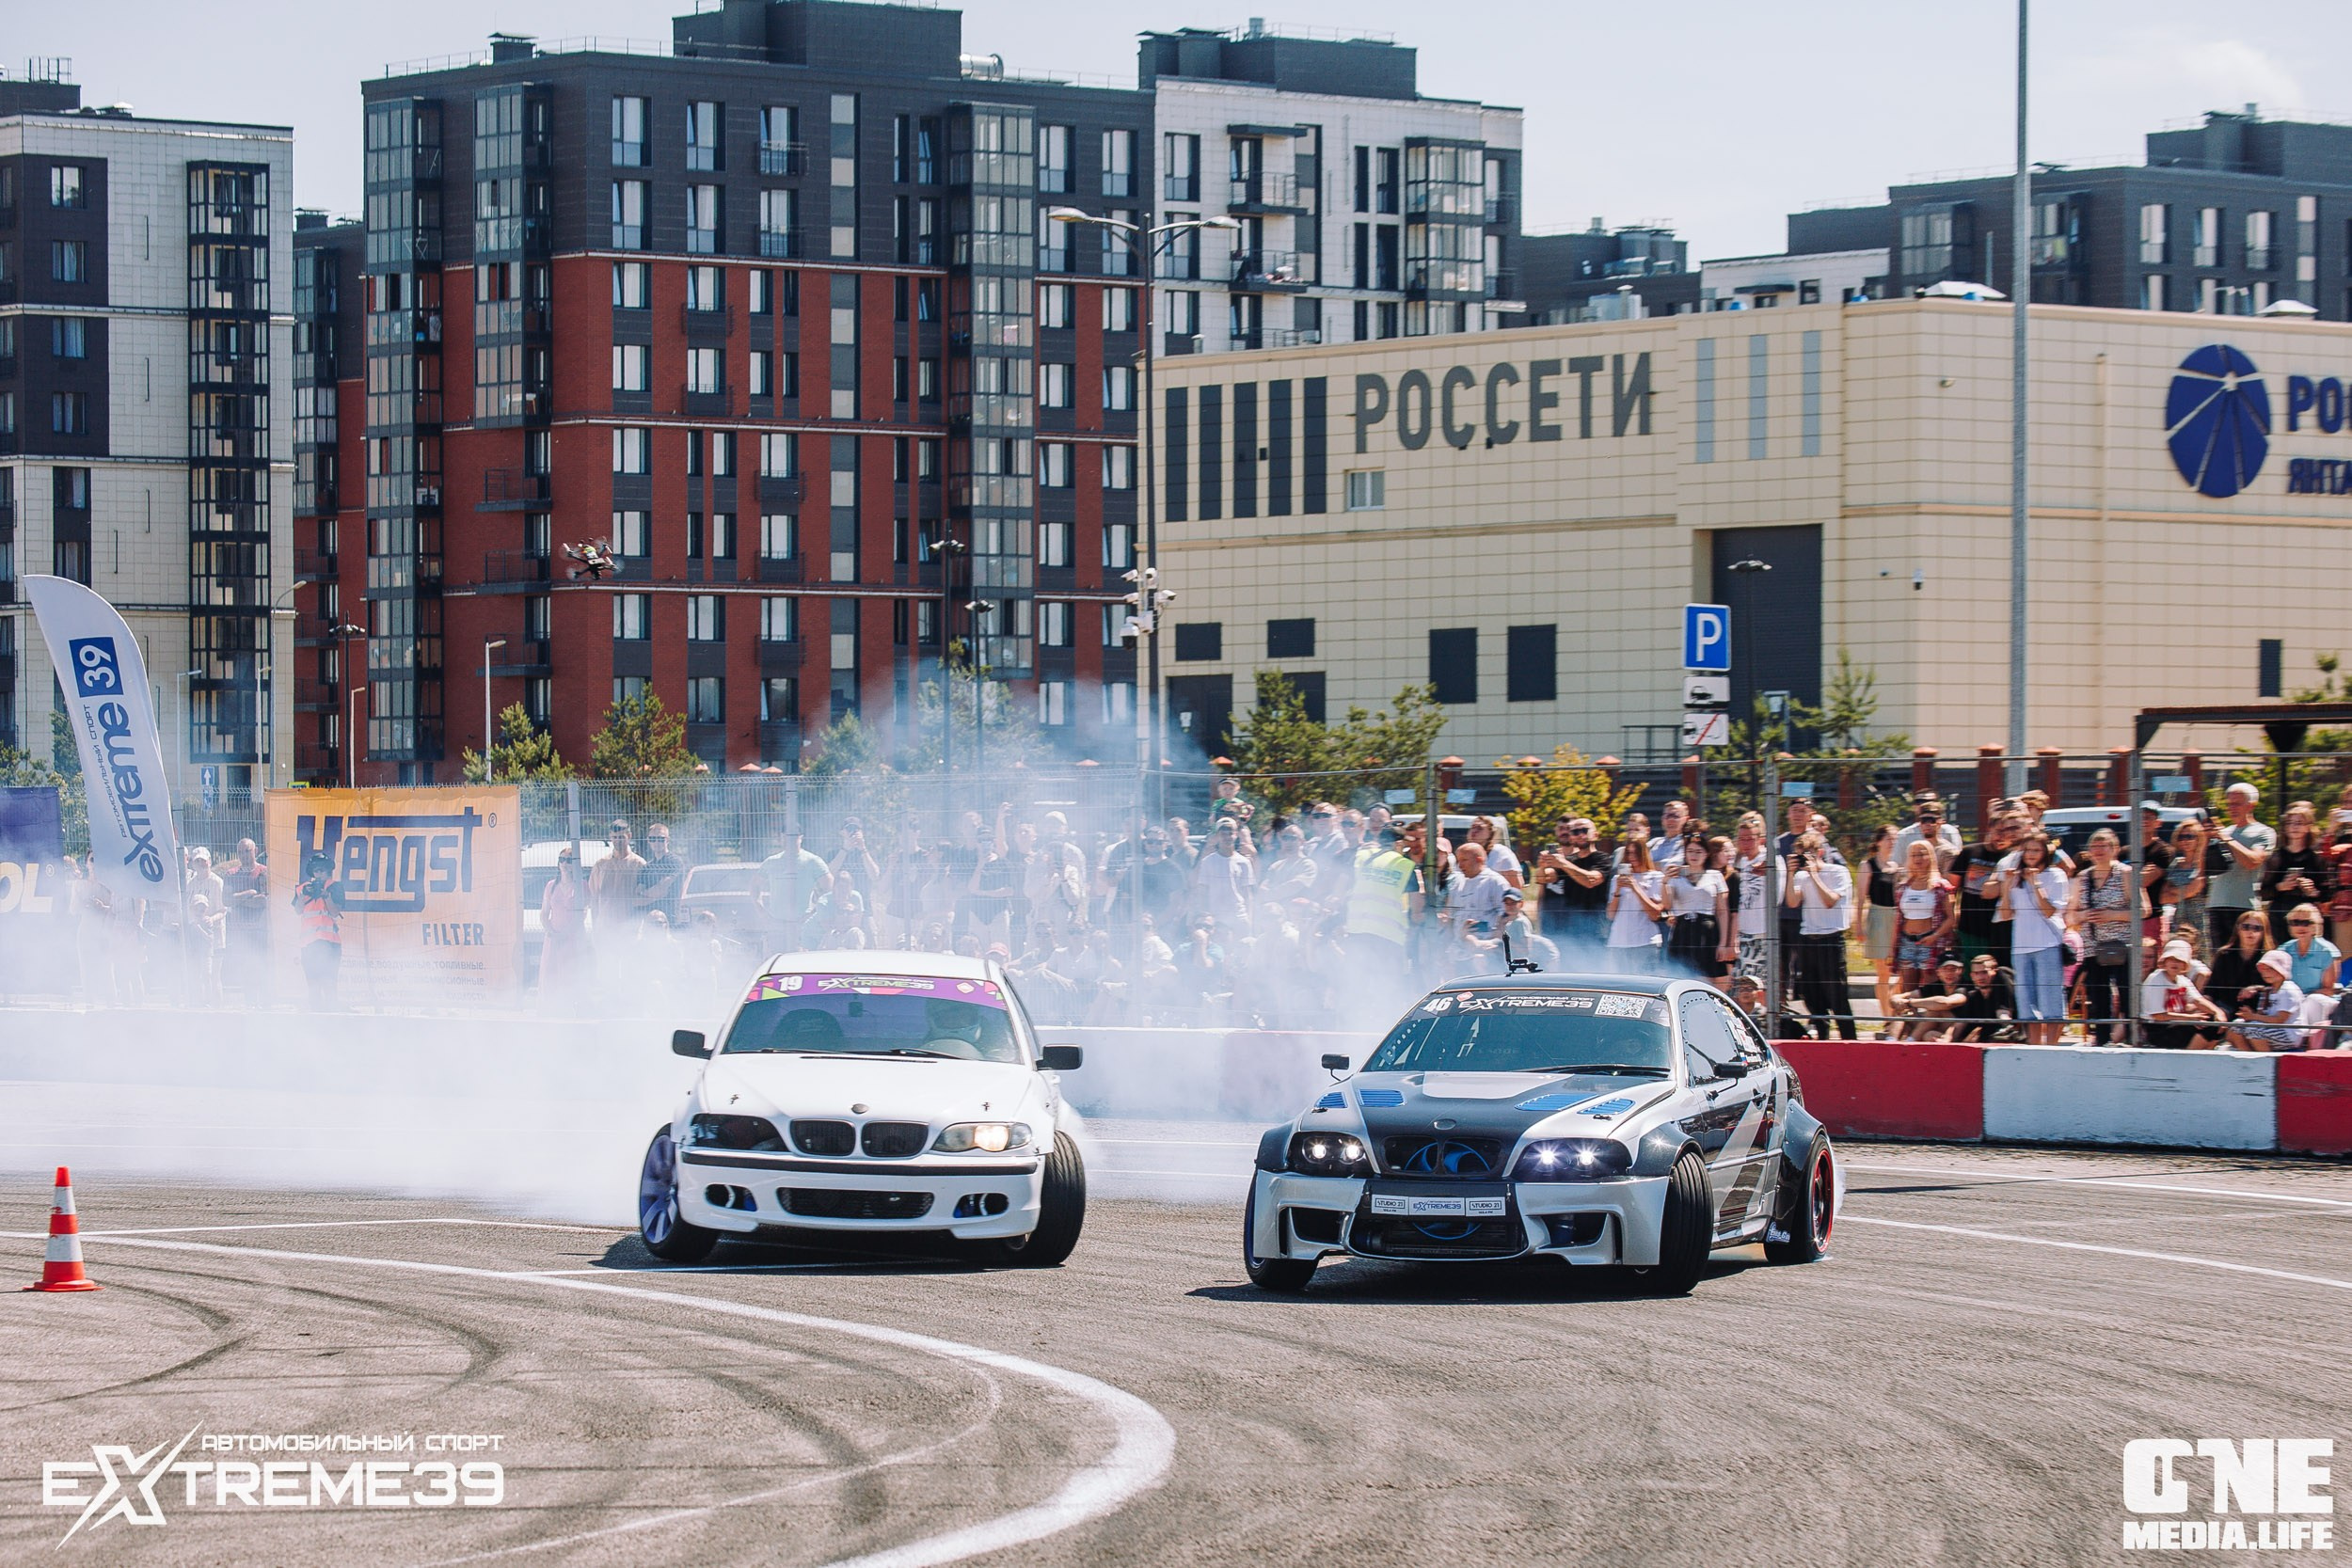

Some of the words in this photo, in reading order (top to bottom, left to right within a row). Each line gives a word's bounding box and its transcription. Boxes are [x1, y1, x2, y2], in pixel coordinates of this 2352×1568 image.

[1355, 352, 1652, 453] РОССЕТИ
[2288, 375, 2352, 434] РО
[1696, 613, 1723, 661] P
[79, 645, 115, 688] 39
[83, 705, 97, 740] СПОРТ
[295, 806, 482, 912] Hengst
[422, 923, 485, 945] FILTER
[778, 975, 804, 991] 19
[1422, 996, 1454, 1011] 46
[1458, 995, 1594, 1014] EXTREME39
